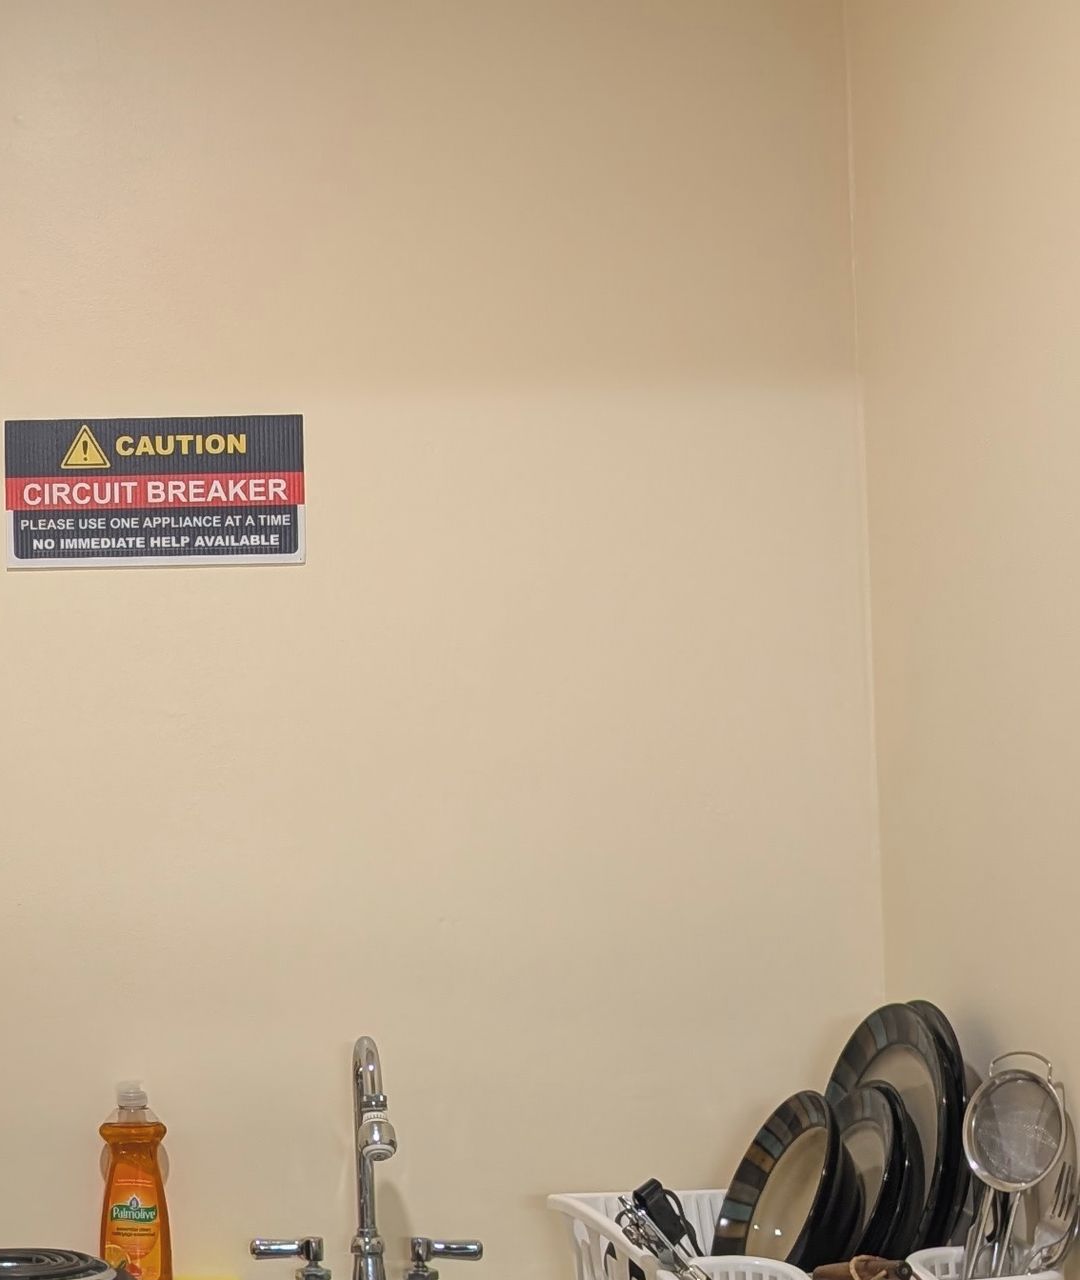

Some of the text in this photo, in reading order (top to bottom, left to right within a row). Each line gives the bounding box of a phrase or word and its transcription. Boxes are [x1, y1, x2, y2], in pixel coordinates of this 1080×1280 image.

[115, 433, 247, 456] CAUTION
[23, 478, 289, 506] CIRCUIT BREAKER
[20, 514, 292, 531] PLEASE USE ONE APPLIANCE AT A TIME
[32, 533, 280, 550] NO IMMEDIATE HELP AVAILABLE
[113, 1206, 156, 1219] Palmolive
